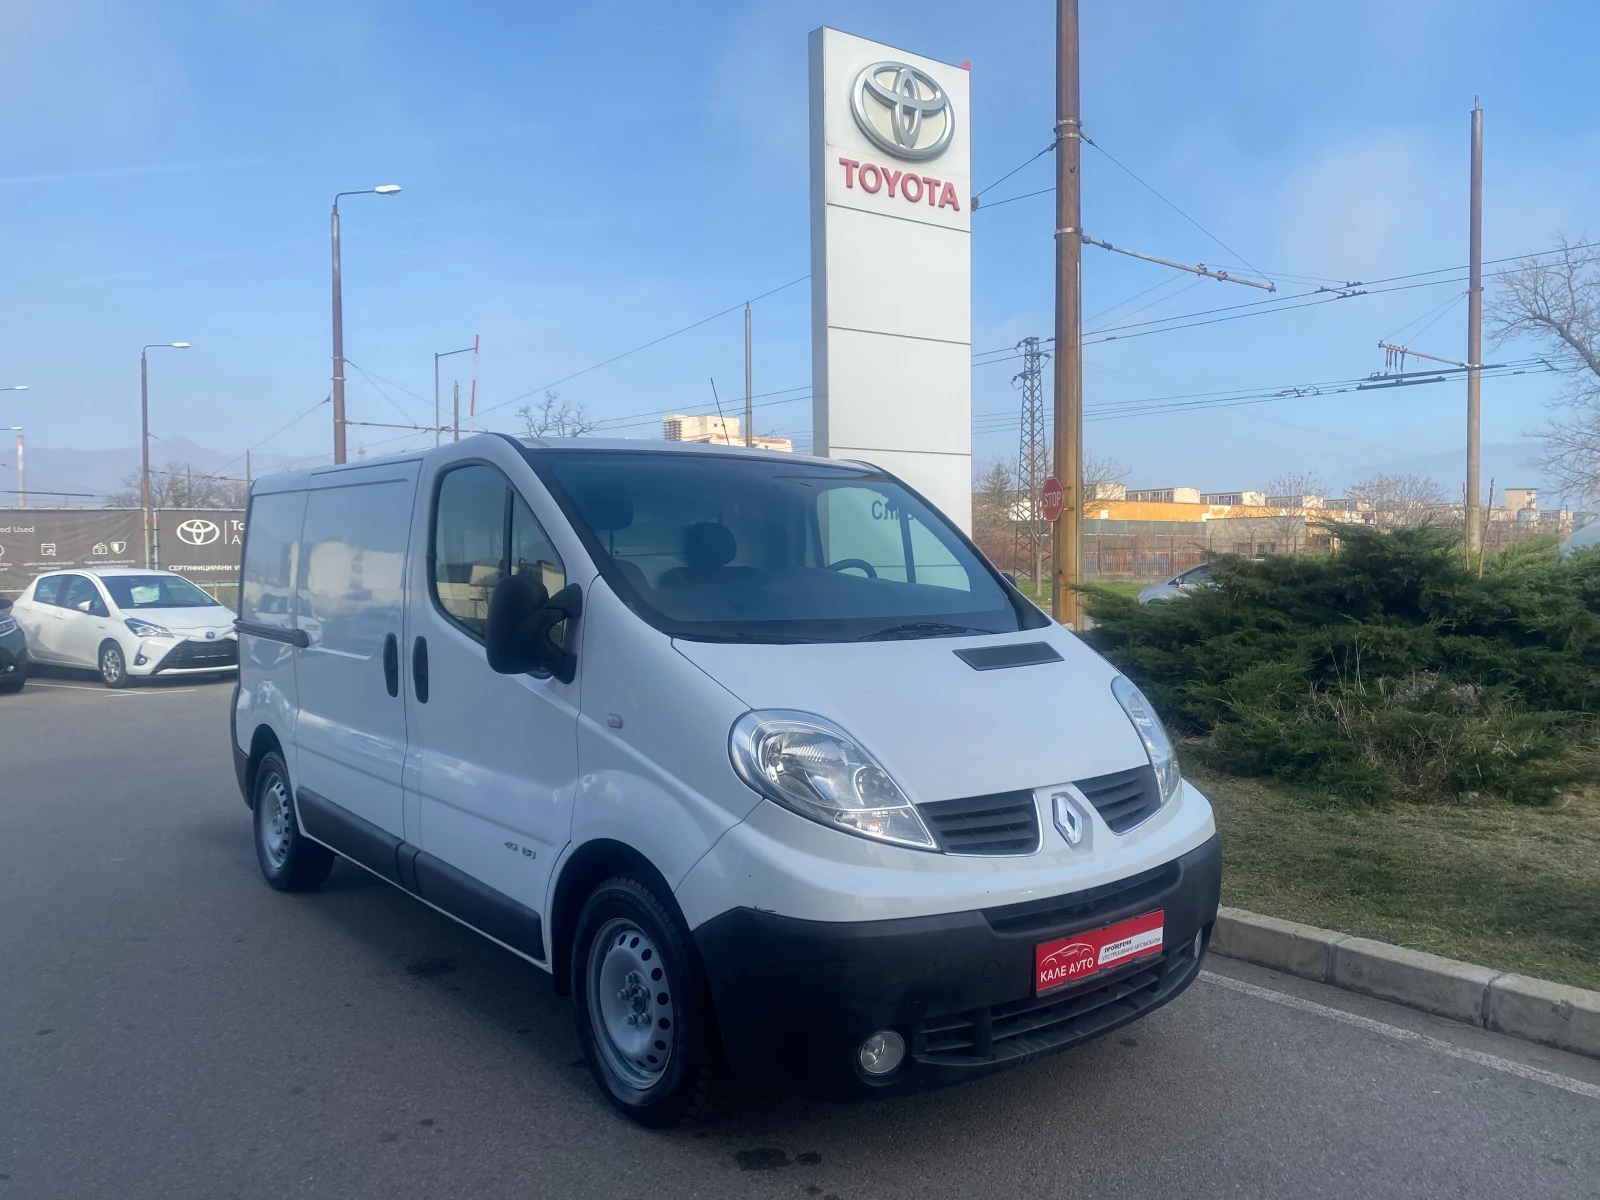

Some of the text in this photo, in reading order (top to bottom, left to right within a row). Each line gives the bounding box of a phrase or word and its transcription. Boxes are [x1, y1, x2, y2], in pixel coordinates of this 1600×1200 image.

[839, 157, 960, 212] TOYOTA
[1043, 491, 1062, 508] STOP
[1104, 939, 1132, 953] ПРОВЕРЕНИ
[1040, 965, 1067, 983] КАЛЕ
[1069, 957, 1094, 974] АУТО
